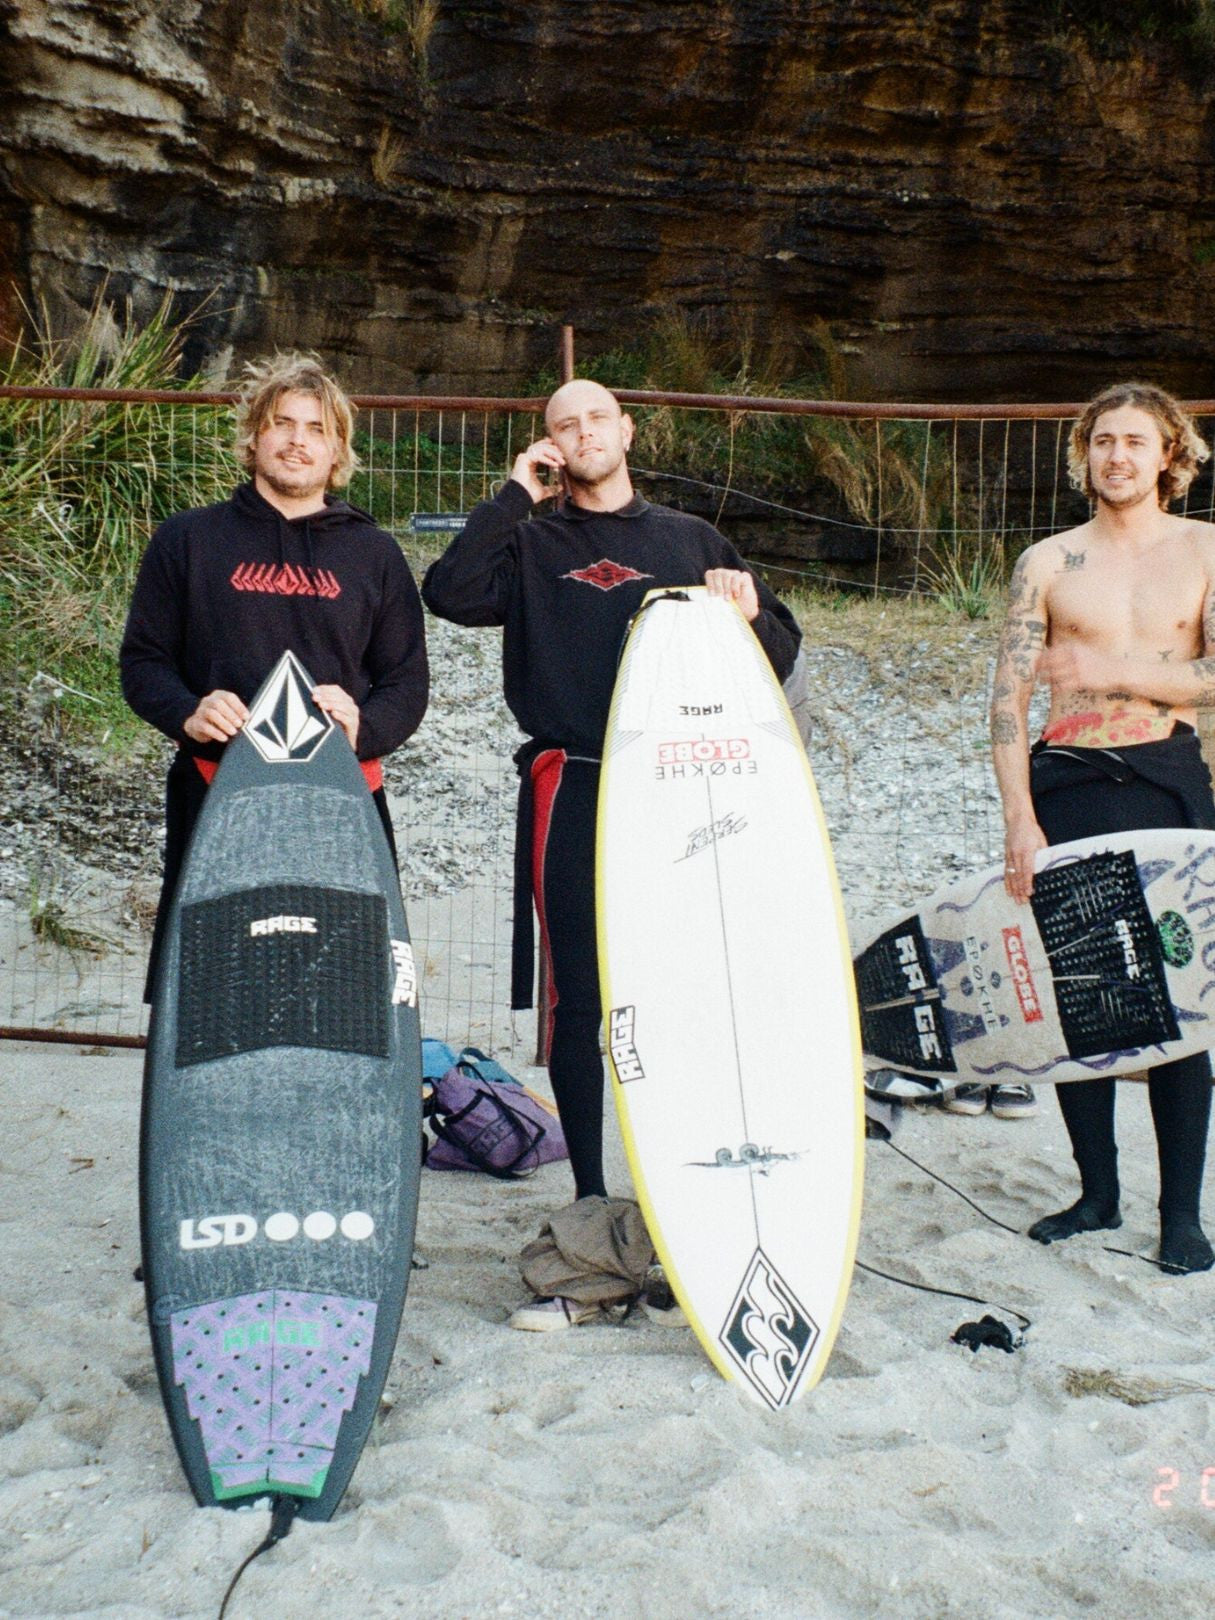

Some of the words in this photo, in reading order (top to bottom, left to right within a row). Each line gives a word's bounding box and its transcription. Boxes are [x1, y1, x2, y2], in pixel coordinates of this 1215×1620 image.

[679, 704, 723, 715] RAGE
[658, 739, 750, 764] GLOBE
[251, 915, 318, 937] RAGE
[1115, 918, 1140, 980] RAGE
[390, 940, 416, 1008] RAGE
[1007, 934, 1037, 1013] GLOBE
[609, 1005, 645, 1084] RAGE
[179, 1214, 258, 1249] LSD
[223, 1320, 322, 1352] RAGE
